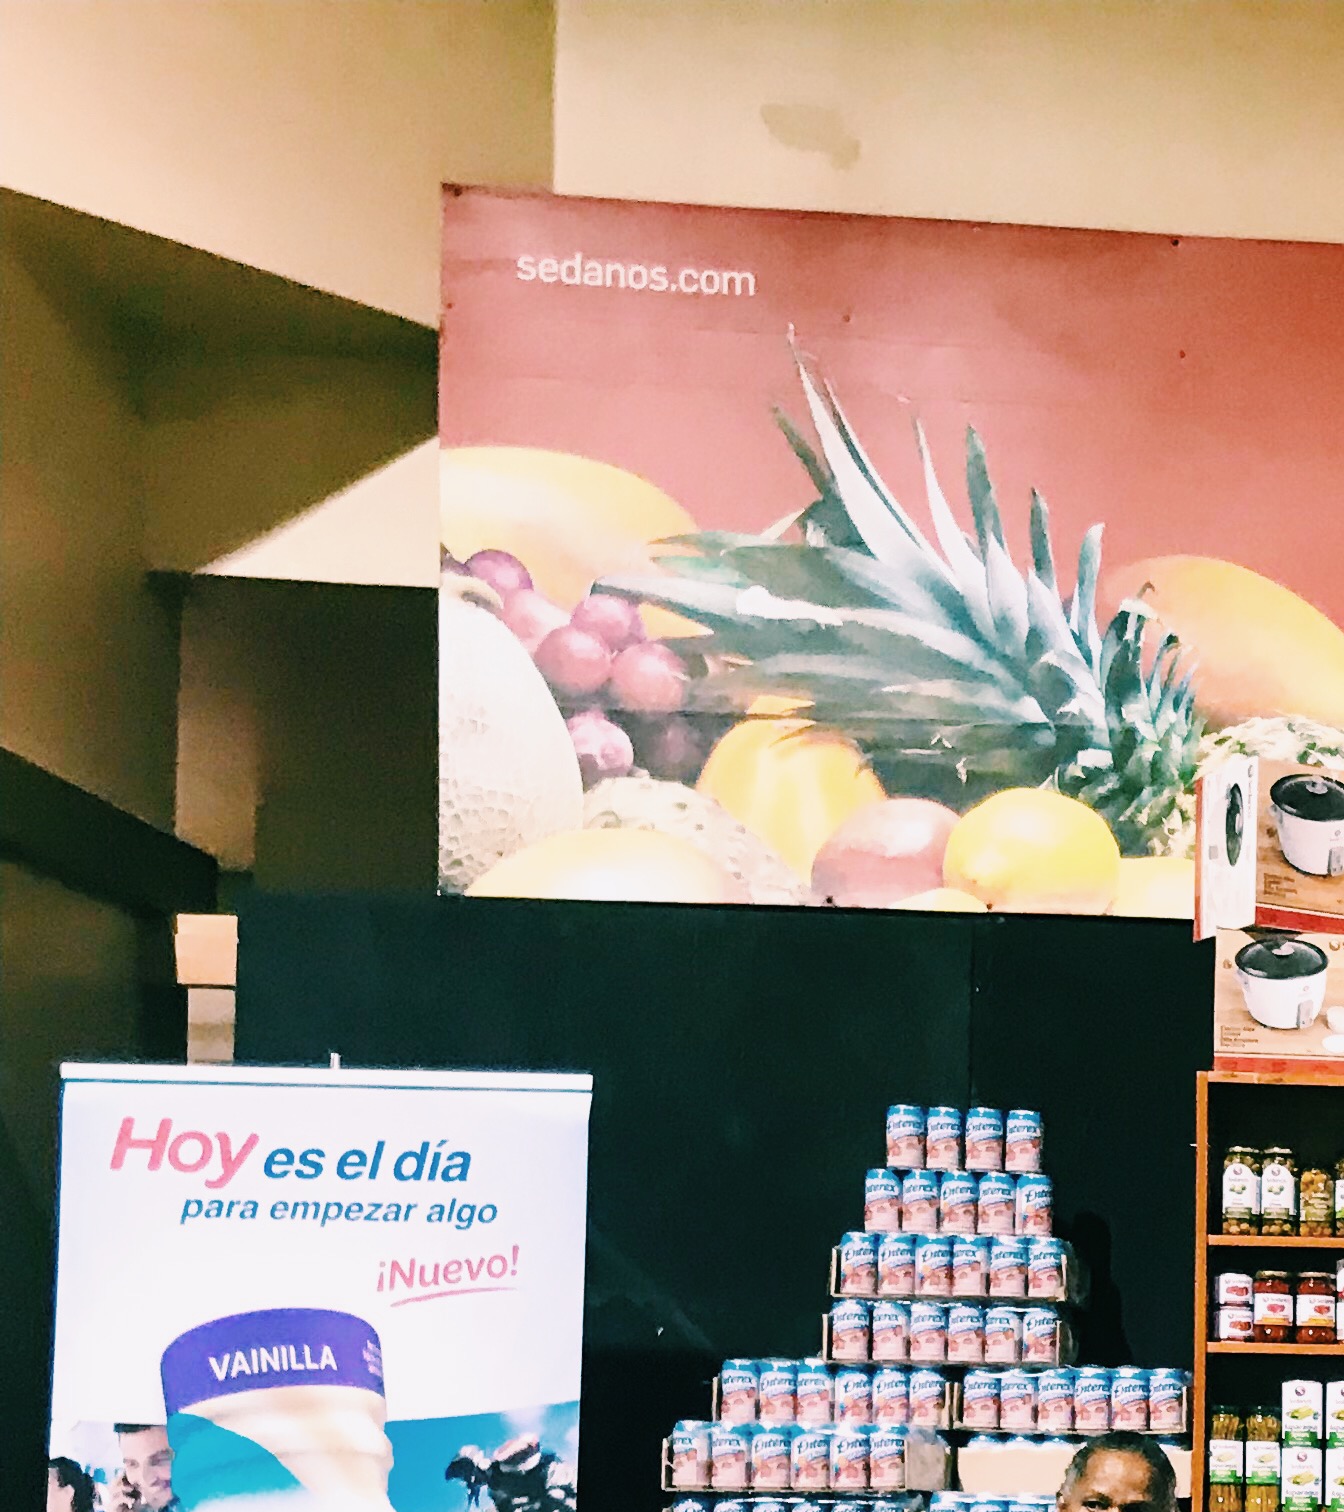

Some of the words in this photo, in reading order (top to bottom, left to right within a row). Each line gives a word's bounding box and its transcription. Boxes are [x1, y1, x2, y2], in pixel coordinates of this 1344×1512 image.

[516, 251, 756, 297] sedanos.com
[110, 1116, 260, 1189] Hoy
[263, 1146, 323, 1182] es
[336, 1140, 384, 1181] el
[393, 1138, 473, 1183] día
[180, 1198, 259, 1227] para
[269, 1198, 417, 1228] empezar
[426, 1196, 499, 1230] algo
[375, 1244, 521, 1292] ¡Nuevo!
[208, 1344, 338, 1383] VAINILLA
